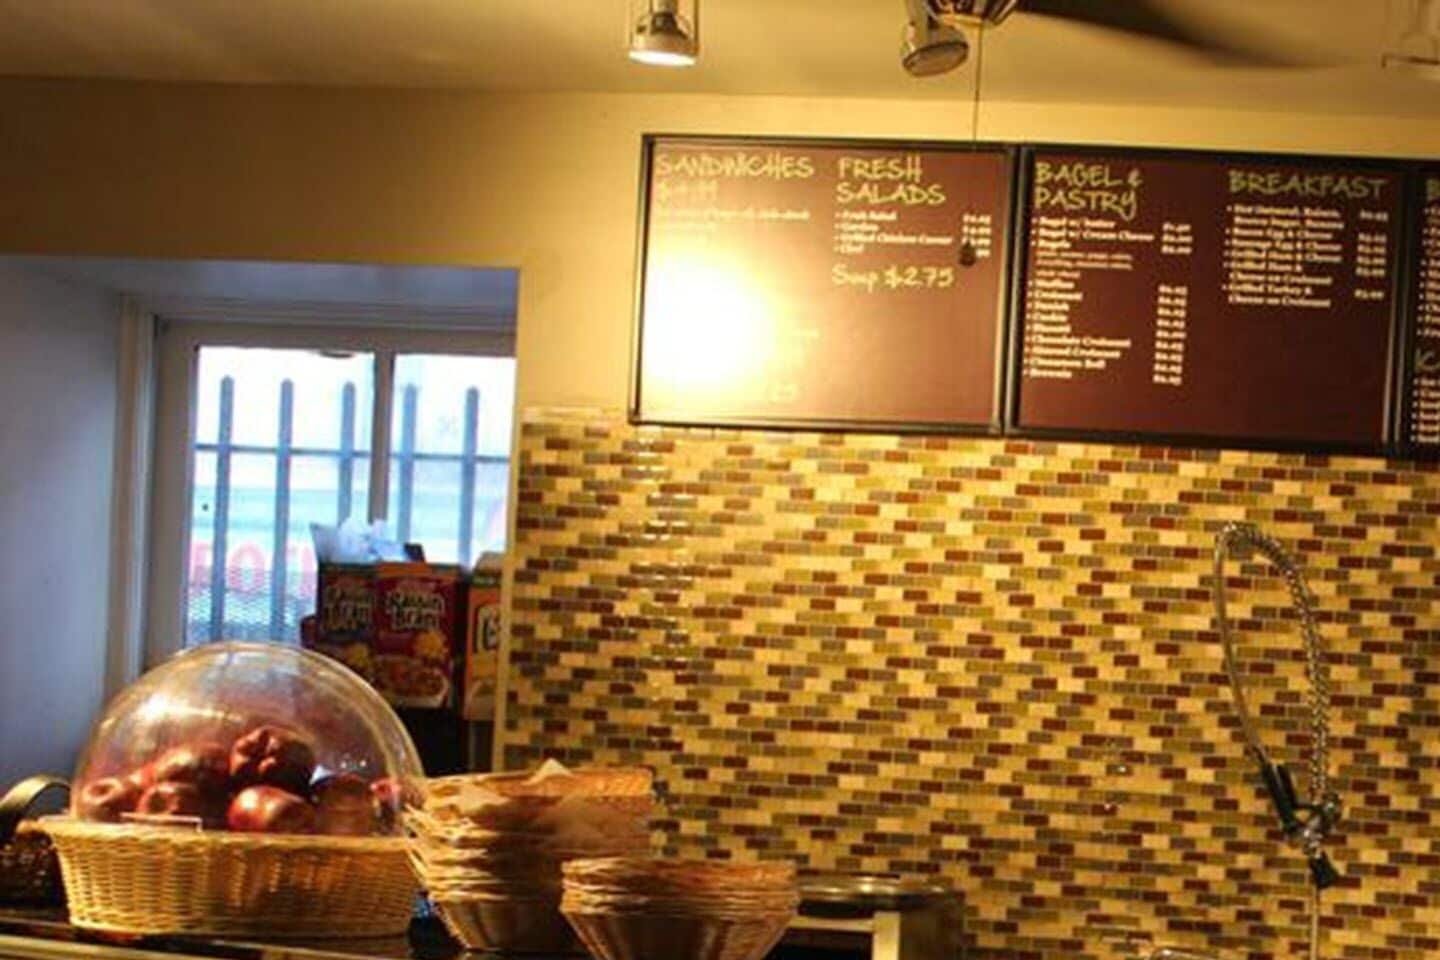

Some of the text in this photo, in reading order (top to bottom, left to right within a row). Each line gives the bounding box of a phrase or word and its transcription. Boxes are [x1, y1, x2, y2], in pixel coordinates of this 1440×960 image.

[656, 151, 815, 180] SANDWICHES
[838, 152, 923, 182] FRESH
[1034, 161, 1123, 186] BAGEL
[835, 183, 946, 205] SALADS
[1229, 170, 1389, 199] BREAKFAST
[1034, 187, 1139, 220] PASTRY
